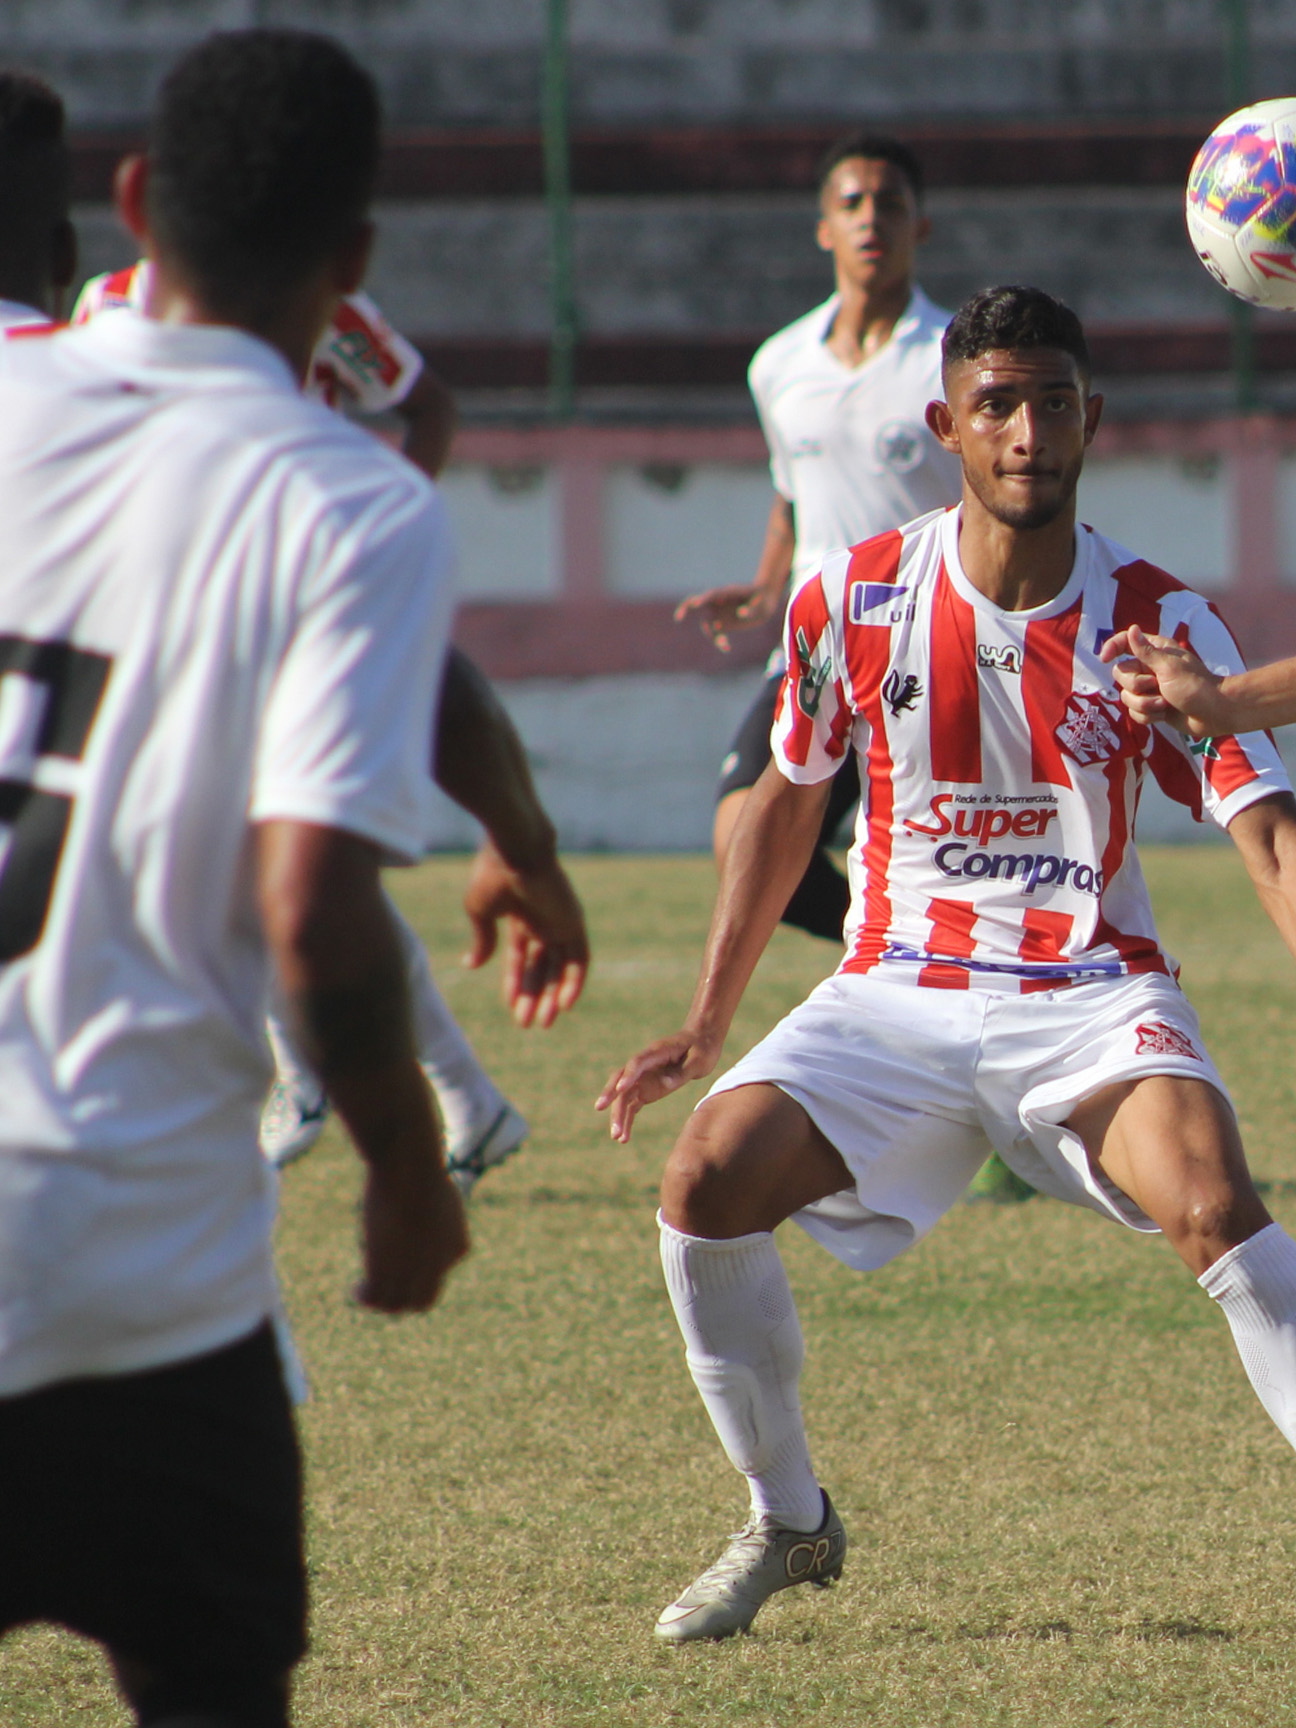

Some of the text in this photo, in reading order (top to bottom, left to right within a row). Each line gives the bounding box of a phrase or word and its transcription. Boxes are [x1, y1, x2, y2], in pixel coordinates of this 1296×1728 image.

[903, 793, 1058, 846] Super
[955, 793, 976, 804] Rede
[980, 793, 991, 804] de
[934, 842, 1104, 898] Compras
